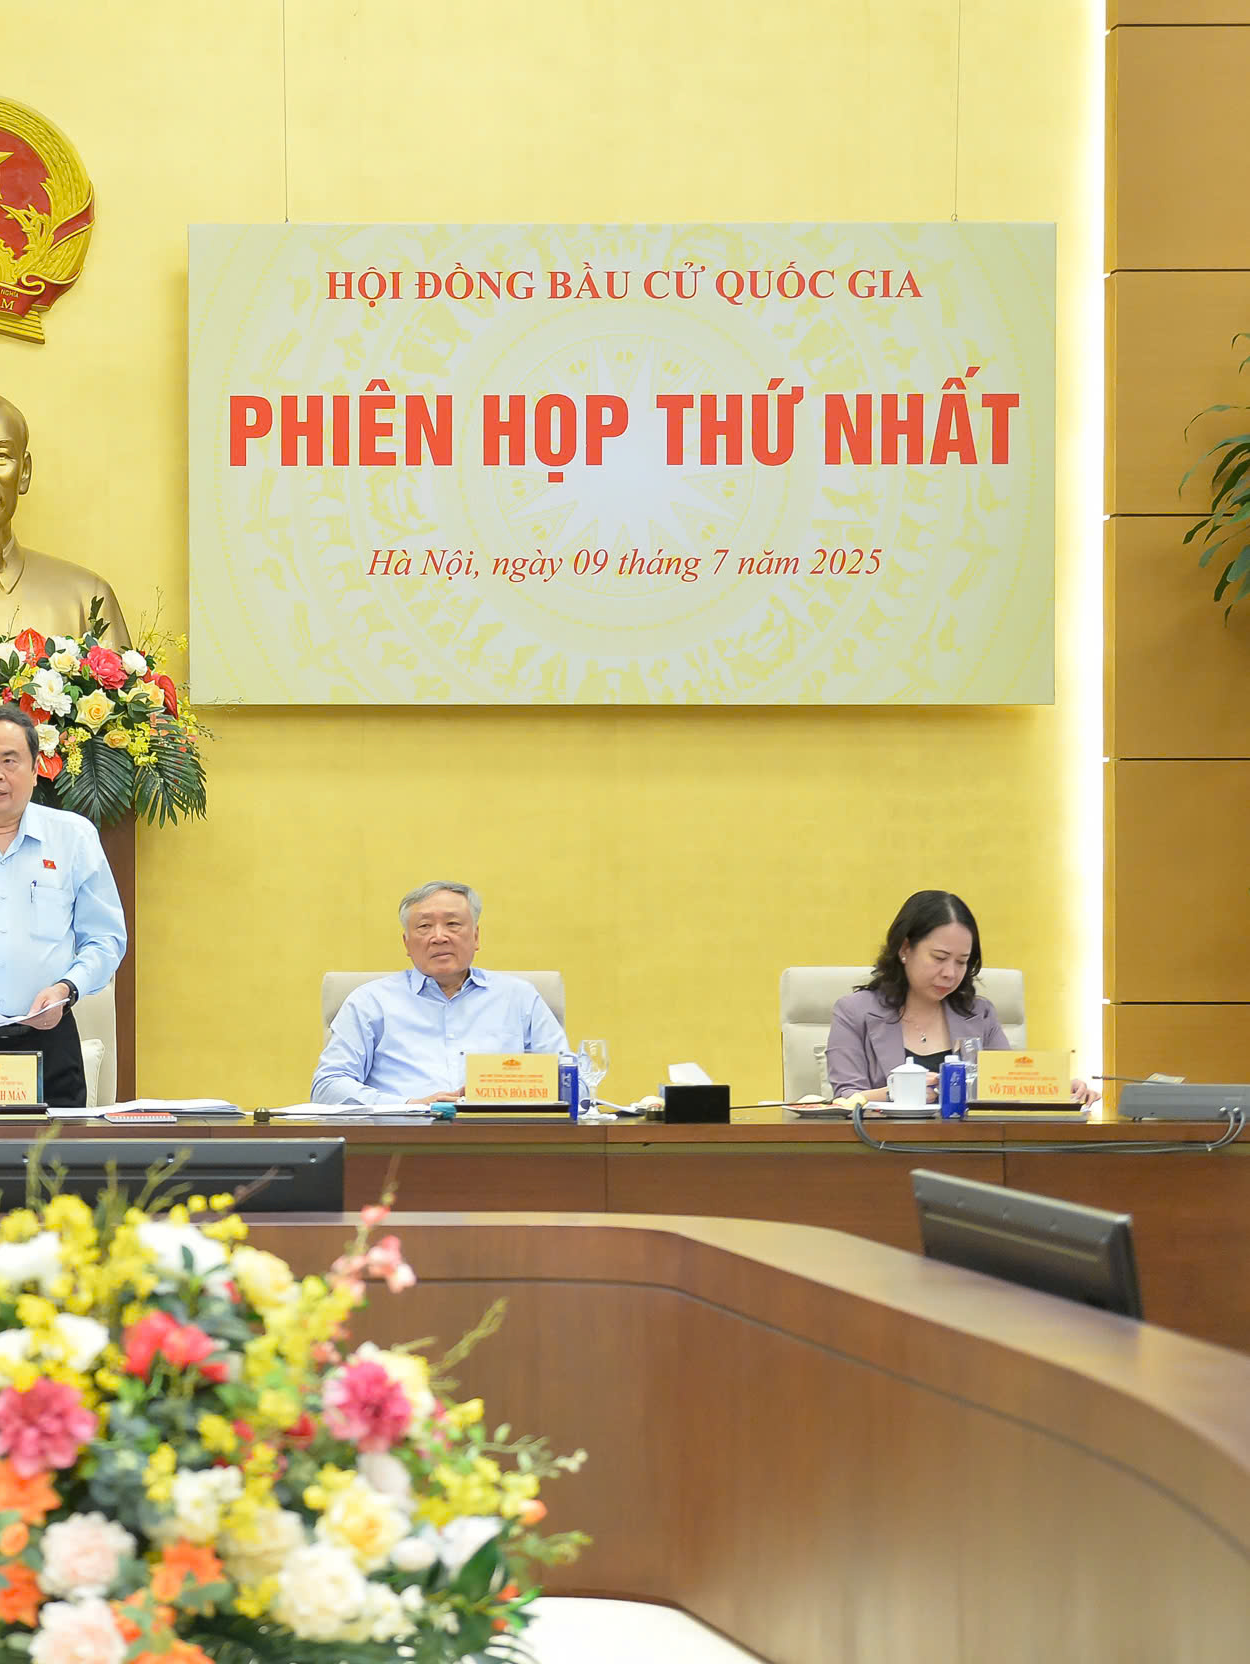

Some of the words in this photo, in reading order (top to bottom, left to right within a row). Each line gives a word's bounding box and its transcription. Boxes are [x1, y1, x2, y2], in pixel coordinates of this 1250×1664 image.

[326, 266, 403, 307] HỘI
[415, 262, 535, 300] ĐỒNG
[547, 262, 631, 300] BẦU
[643, 262, 706, 300] CỬ
[716, 262, 835, 305] QUỐC
[848, 269, 923, 299] GIA
[230, 379, 452, 466] PHIÊN
[484, 394, 628, 483] HỌP
[657, 378, 804, 466] THỨ
[825, 366, 1019, 466] NHẤT
[367, 549, 412, 576] Hà
[421, 548, 481, 582] Nội,
[492, 549, 564, 583] ngày
[573, 549, 609, 575] 09
[618, 548, 702, 583] tháng
[713, 549, 730, 575] 7
[738, 550, 800, 575] năm
[810, 548, 883, 576] 2025
